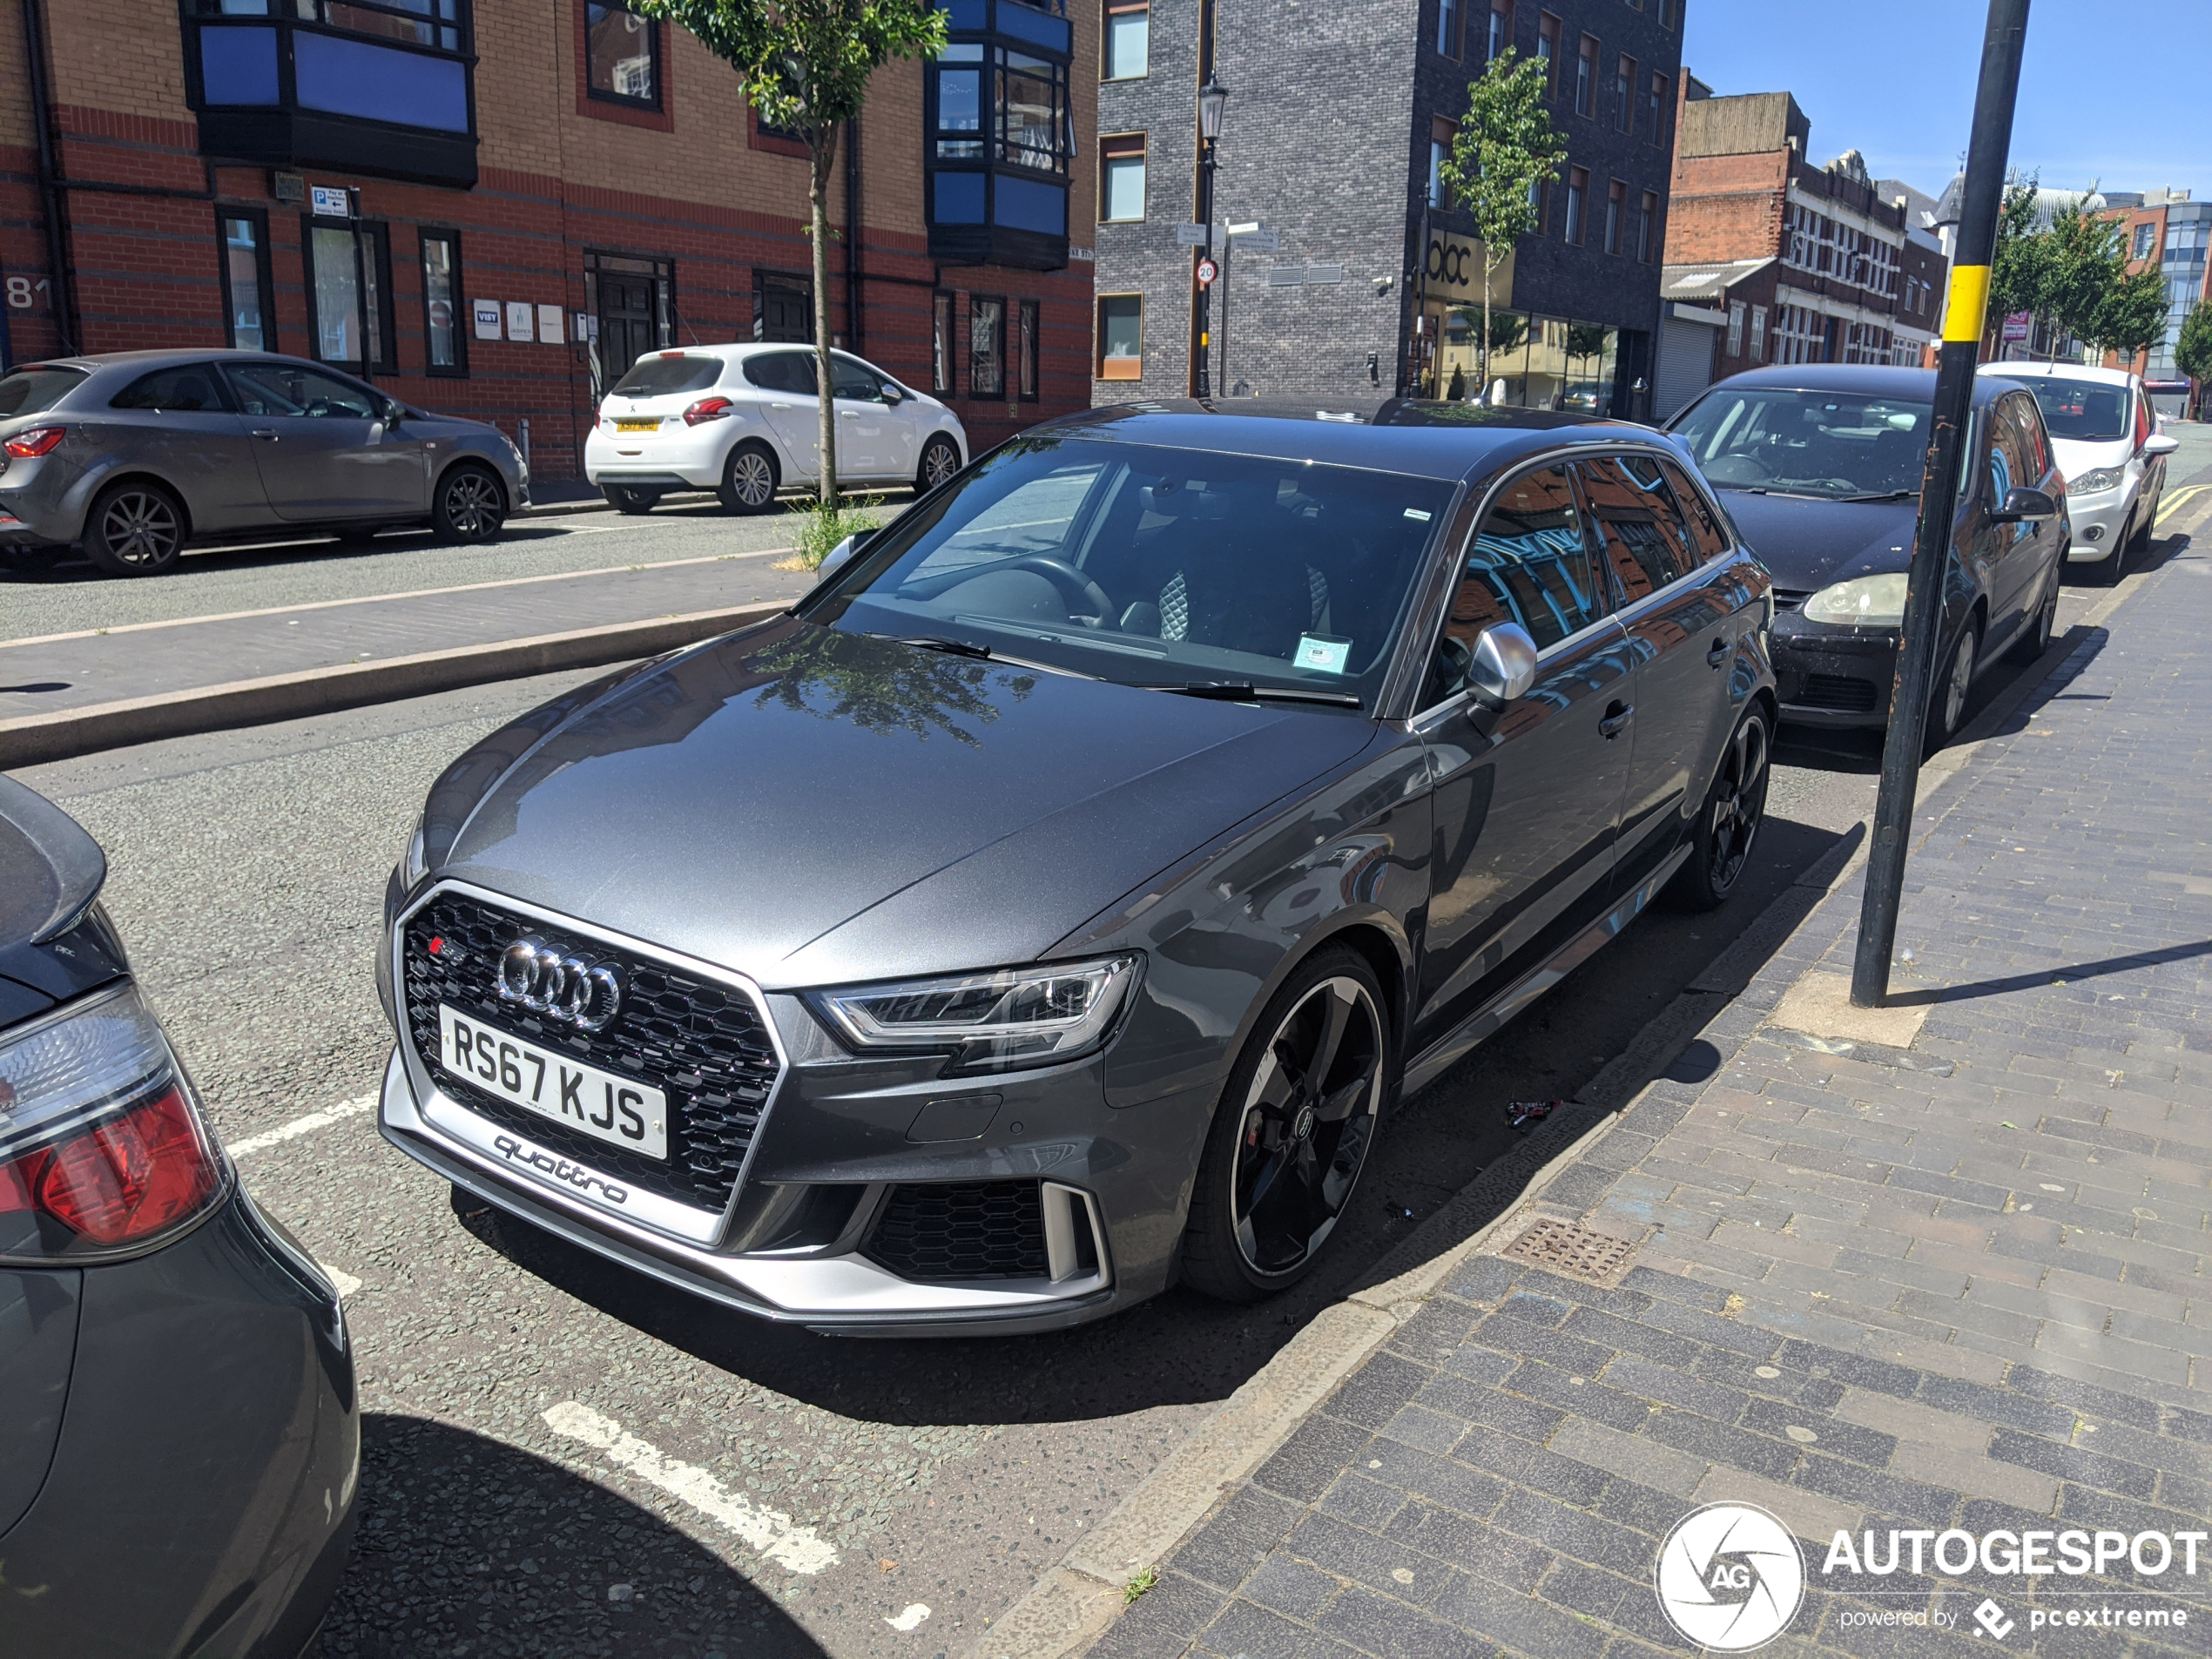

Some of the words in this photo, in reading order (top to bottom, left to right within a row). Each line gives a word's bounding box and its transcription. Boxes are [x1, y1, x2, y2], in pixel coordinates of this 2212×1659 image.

[316, 192, 325, 203] P
[1200, 267, 1212, 277] 20
[7, 276, 52, 309] 81
[478, 313, 497, 322] VISY
[453, 1017, 545, 1103] RS67
[559, 1065, 645, 1141] KJS
[493, 1134, 628, 1204] quattro
